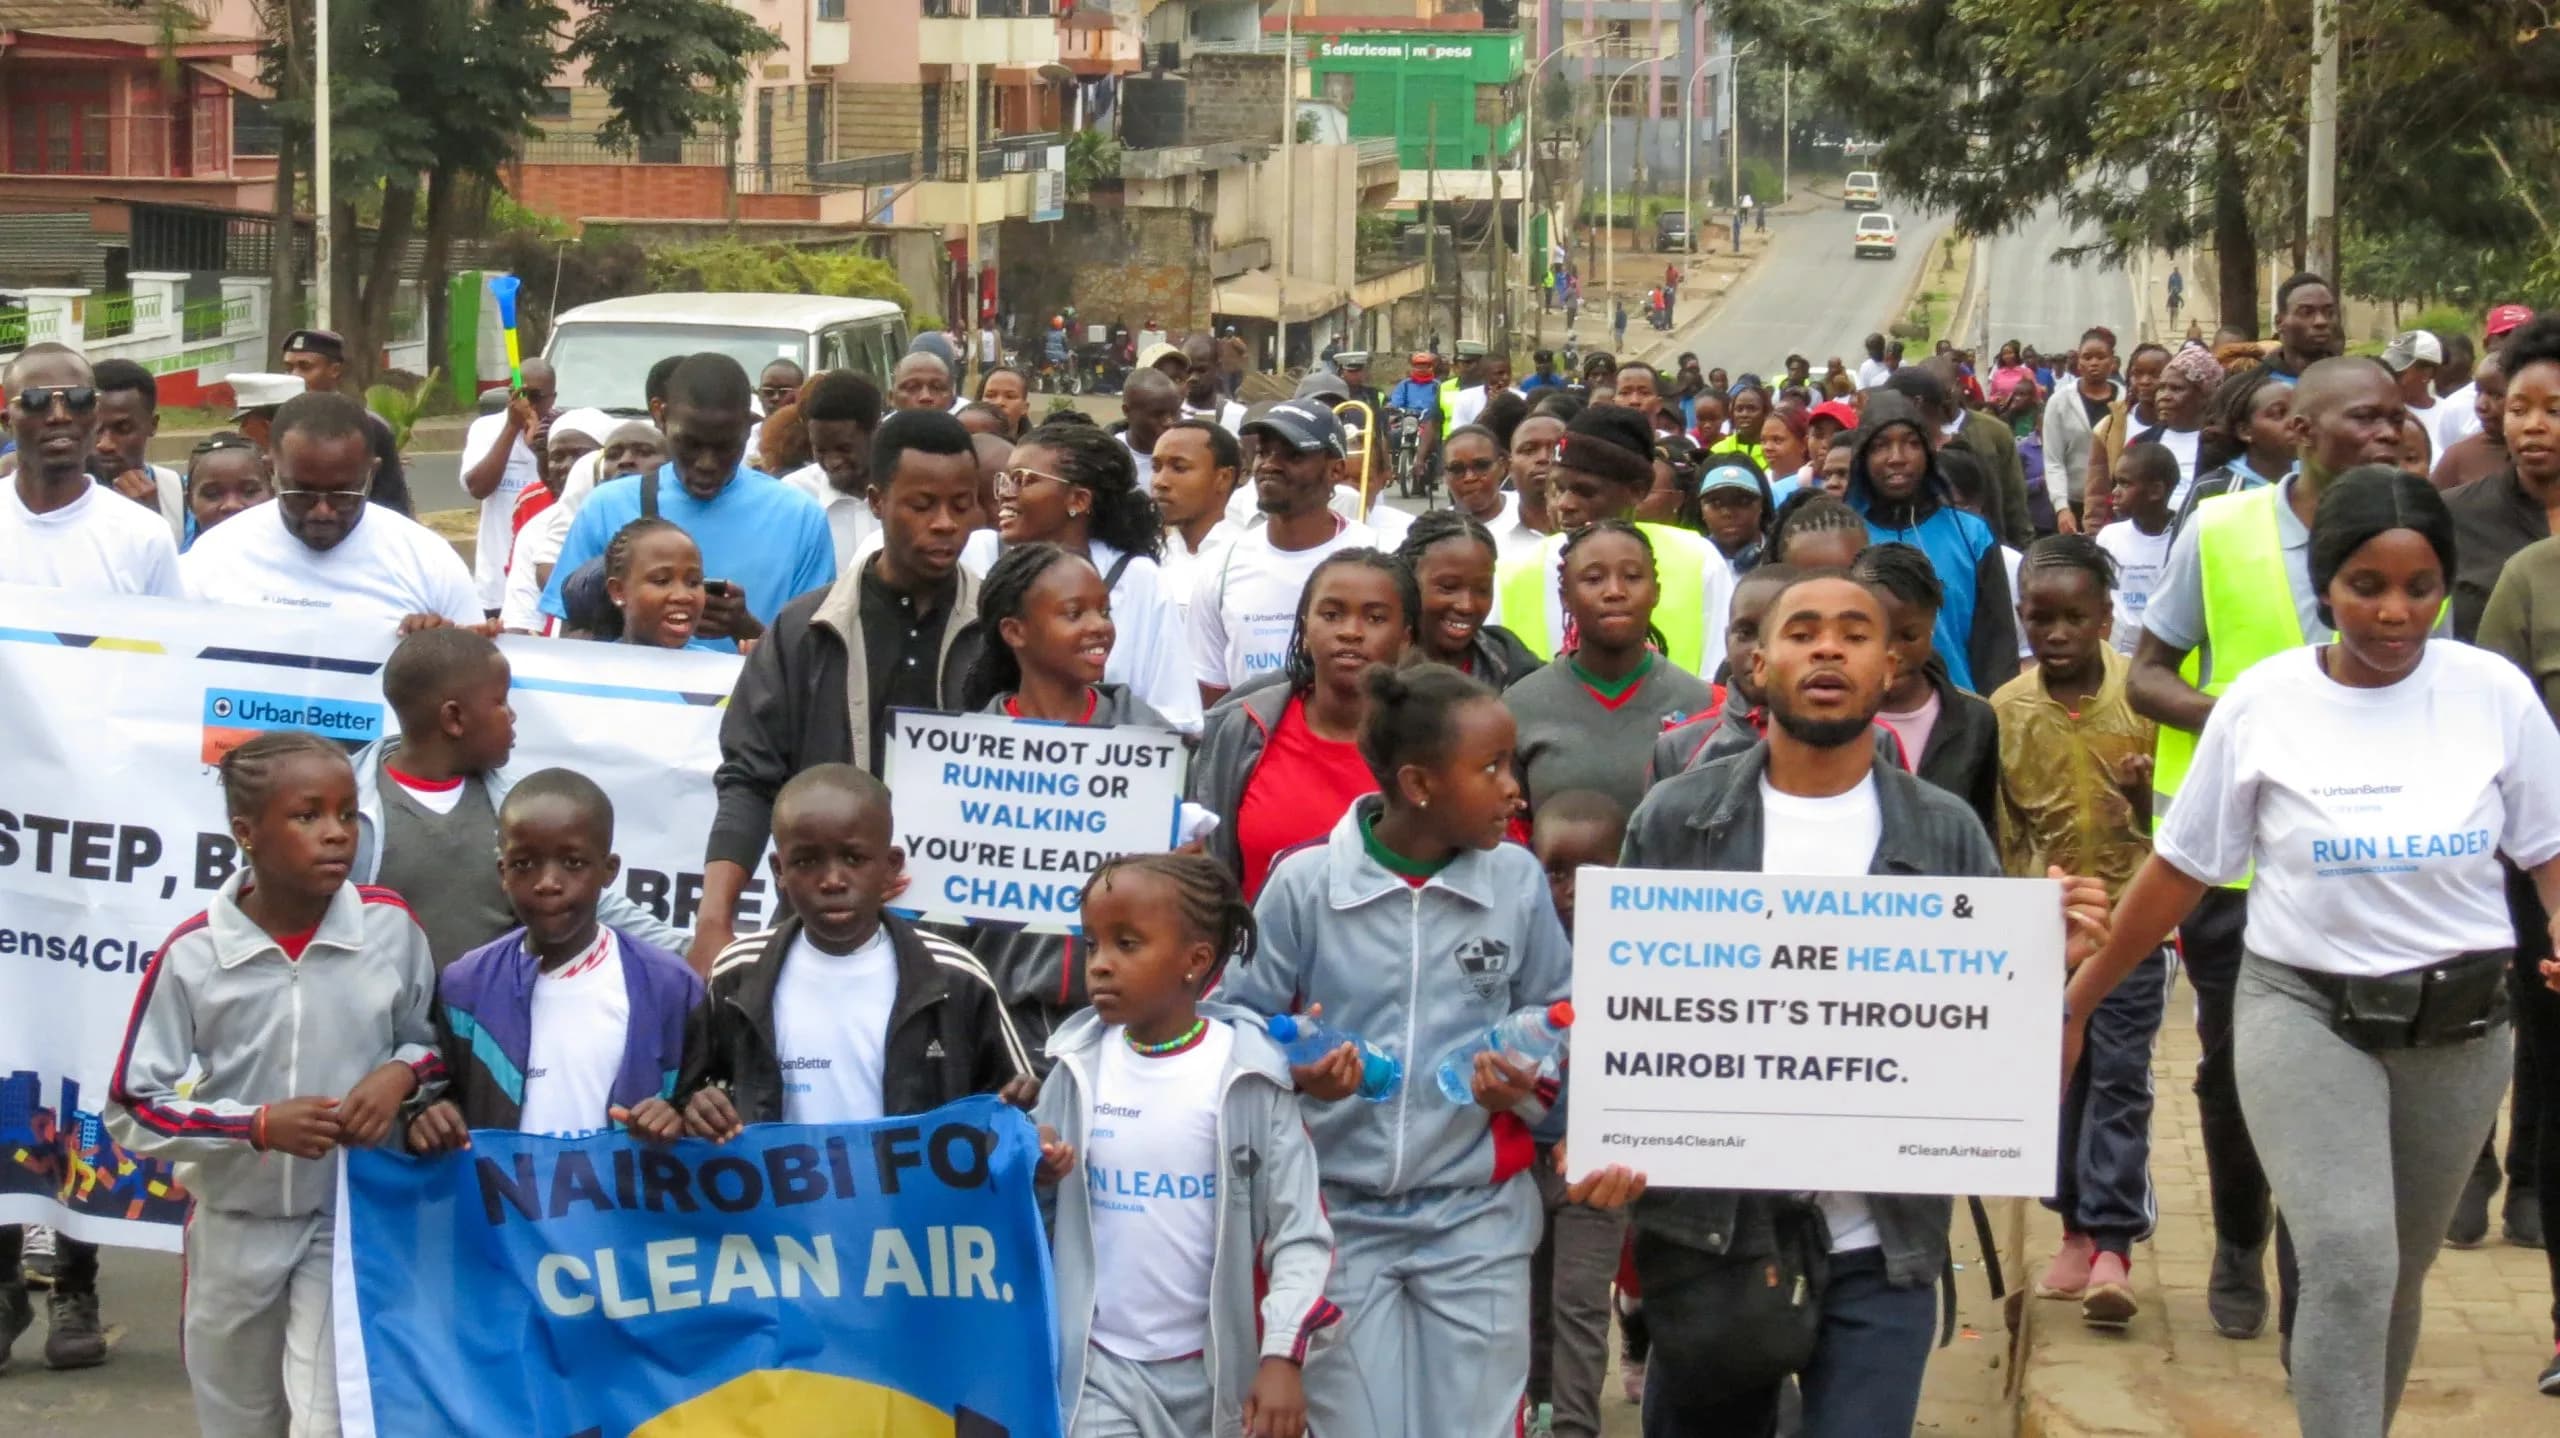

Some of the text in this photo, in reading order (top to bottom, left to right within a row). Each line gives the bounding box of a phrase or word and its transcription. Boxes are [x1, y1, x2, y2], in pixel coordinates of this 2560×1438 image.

[1321, 43, 1402, 57] Safaricom
[1244, 652, 1283, 670] RUN
[239, 699, 376, 731] UrbanBetter
[905, 726, 1175, 768] YOU'RE NOT JUST
[942, 762, 1129, 798] RUNNING OR
[2323, 784, 2403, 797] UrbanBetter
[960, 800, 1107, 833] WALKING
[905, 834, 1016, 868] YOU'RE
[2312, 829, 2489, 863] RUN LEADER
[944, 875, 1081, 913] CHANG
[1610, 885, 1974, 920] RUNNING, WALKING &
[1608, 940, 2014, 981] CYCLING ARE HEALTHY,
[1606, 995, 1988, 1030] UNLESS IT'S THROUGH
[1604, 1051, 1909, 1084] NAIROBI TRAFFIC.
[1601, 1132, 2022, 1159] #Cityzens4CleanAir #CleanAirNairobi
[474, 1122, 999, 1226] NAIROBI FO
[1115, 1169, 1217, 1200] LEADE
[537, 1225, 1014, 1319] CLEAN AIR.
